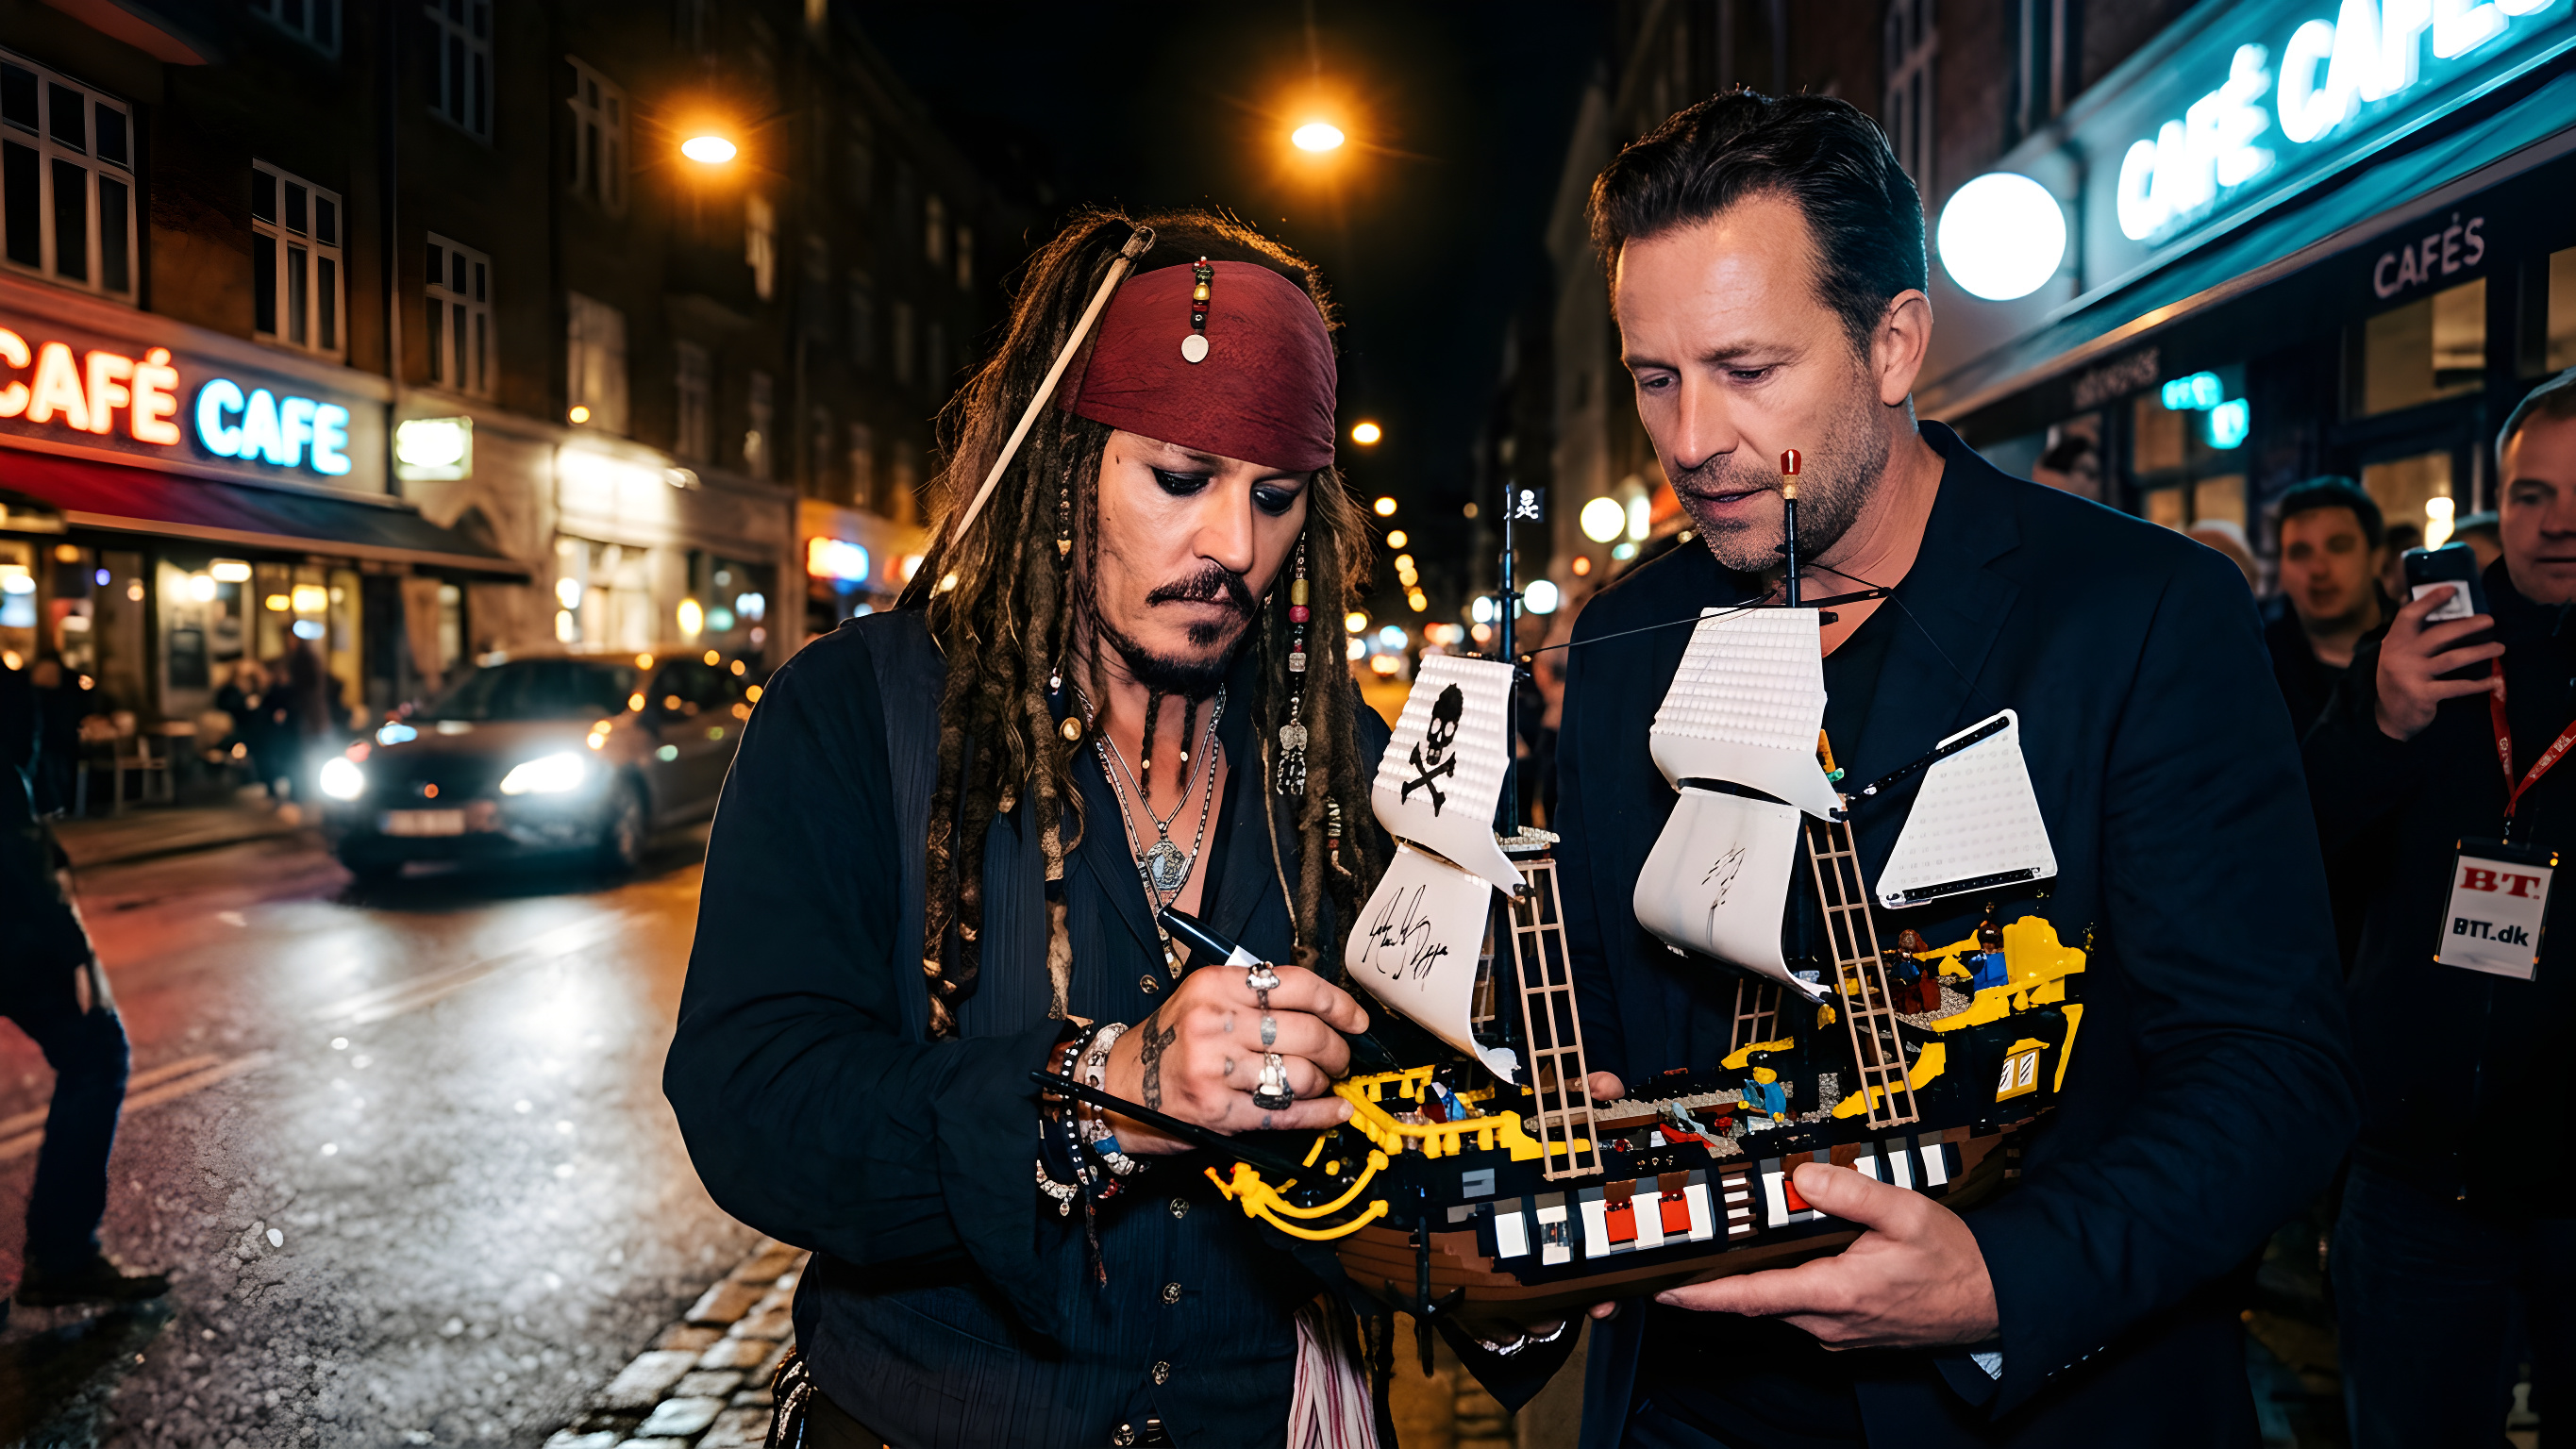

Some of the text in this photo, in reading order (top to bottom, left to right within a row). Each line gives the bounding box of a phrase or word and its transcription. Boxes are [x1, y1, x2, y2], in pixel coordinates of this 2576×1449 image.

[2116, 0, 2553, 241] CAFÉ CAF
[2373, 211, 2485, 299] CAFÉS
[194, 378, 351, 475] CAFE
